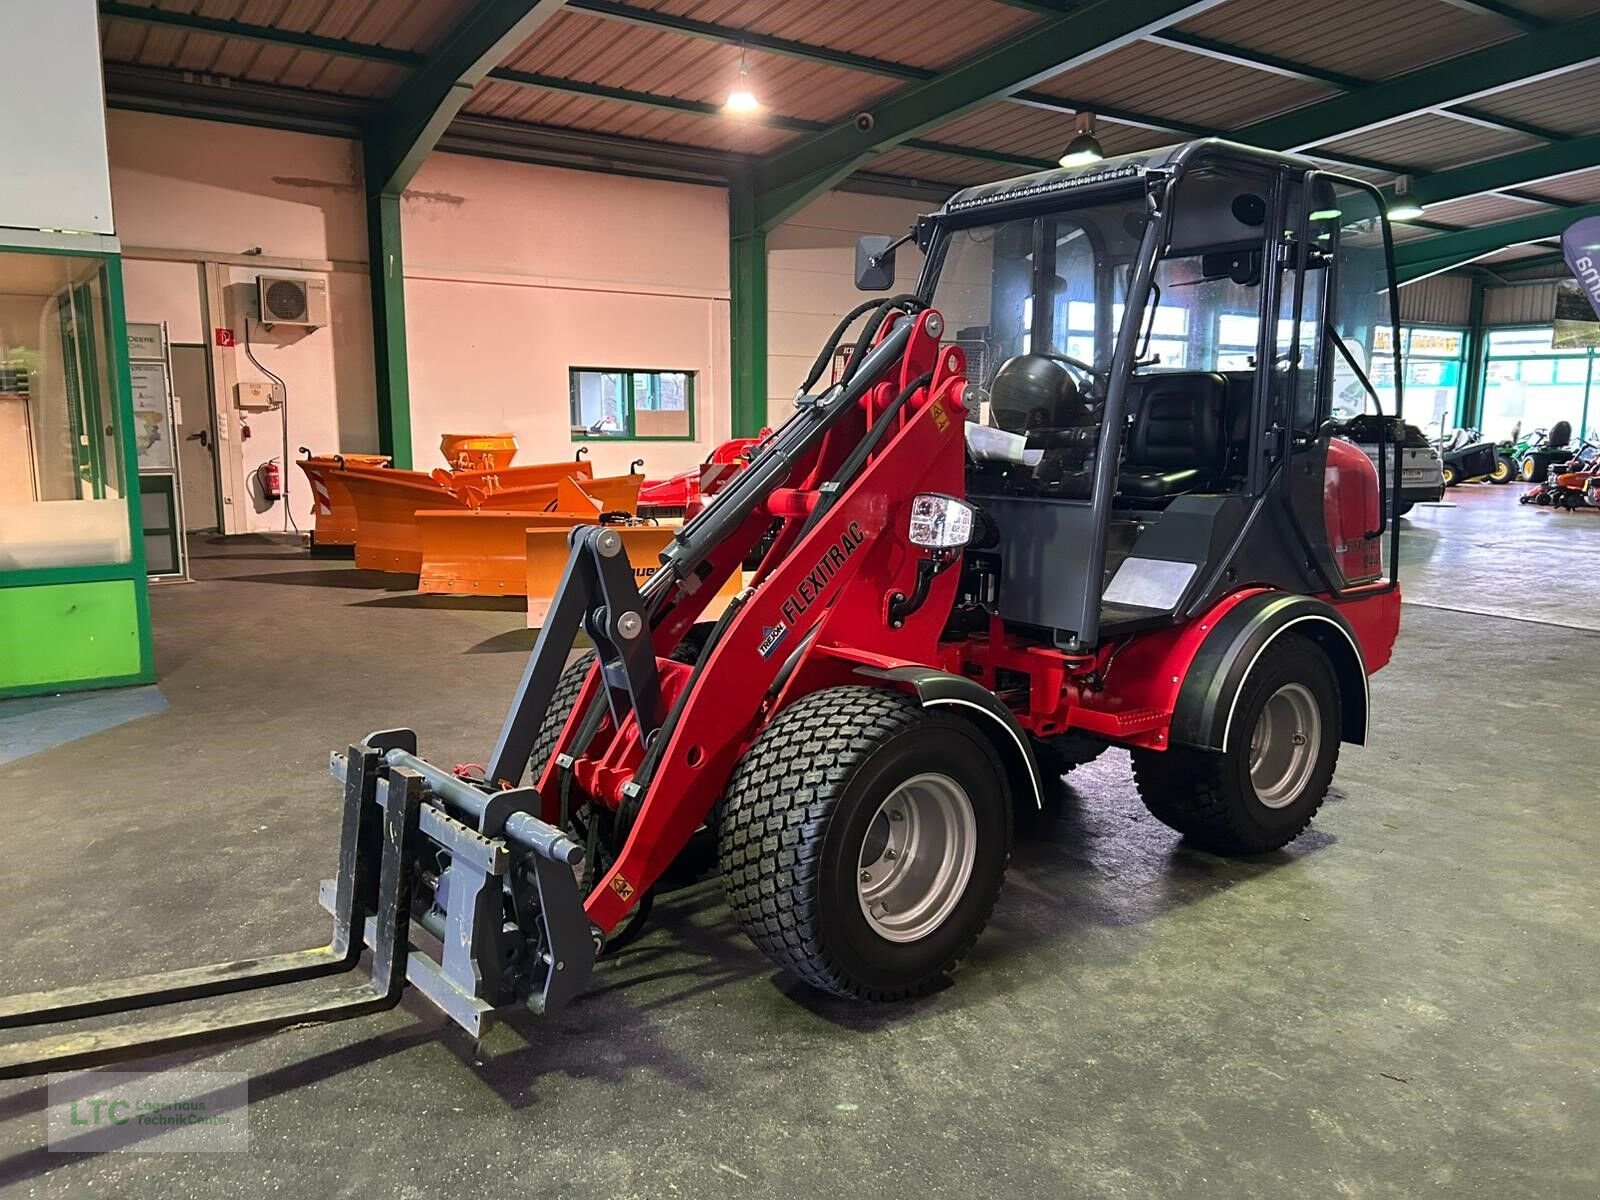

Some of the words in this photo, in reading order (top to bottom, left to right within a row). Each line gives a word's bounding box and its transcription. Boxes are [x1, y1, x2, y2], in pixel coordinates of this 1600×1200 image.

[632, 567, 659, 577] ue
[780, 521, 865, 625] FLEXITRAC
[759, 624, 785, 654] TREJON
